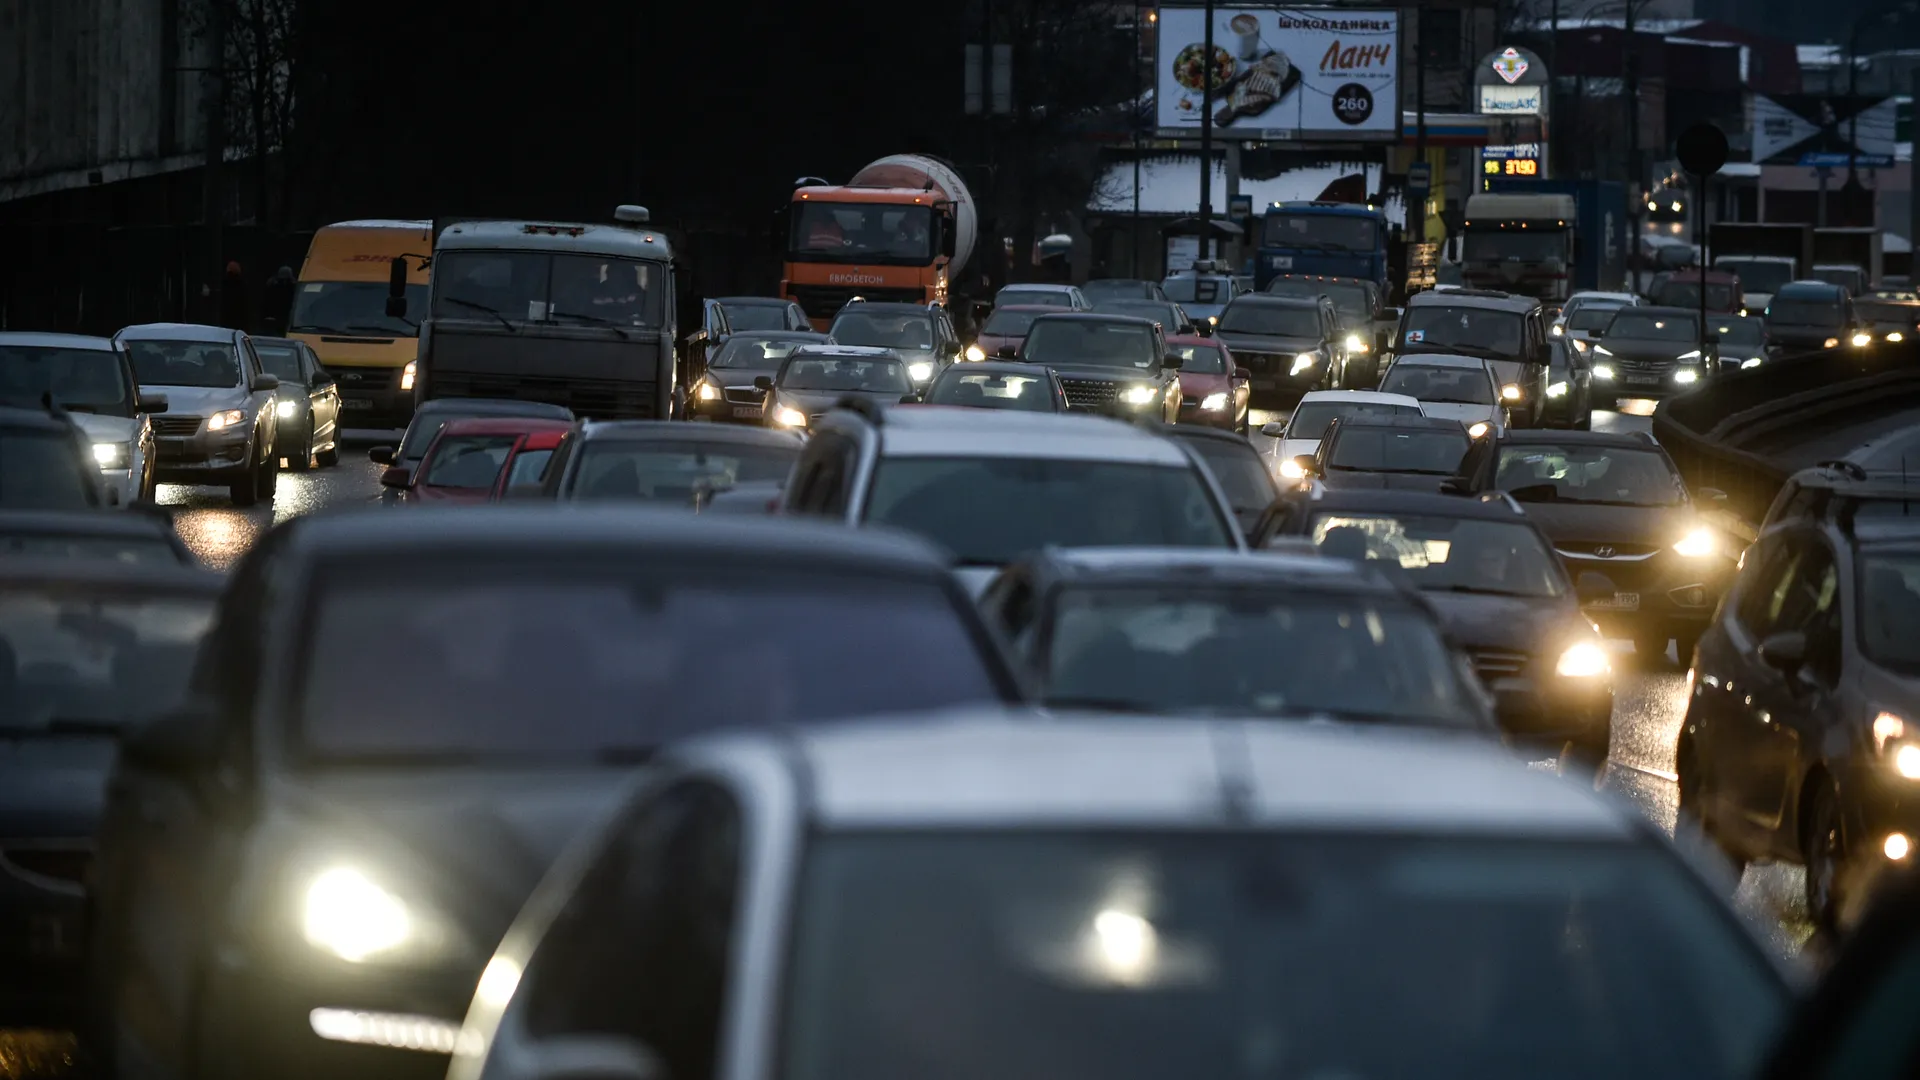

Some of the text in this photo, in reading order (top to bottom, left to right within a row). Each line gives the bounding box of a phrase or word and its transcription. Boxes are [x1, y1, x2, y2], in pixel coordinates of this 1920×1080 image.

[1279, 17, 1390, 30] ШОКОЛАДНИЦА
[1319, 40, 1391, 71] Ланч
[1337, 96, 1368, 110] 260
[1484, 160, 1500, 174] 95
[829, 273, 884, 285] ЕВРОБЕТОН
